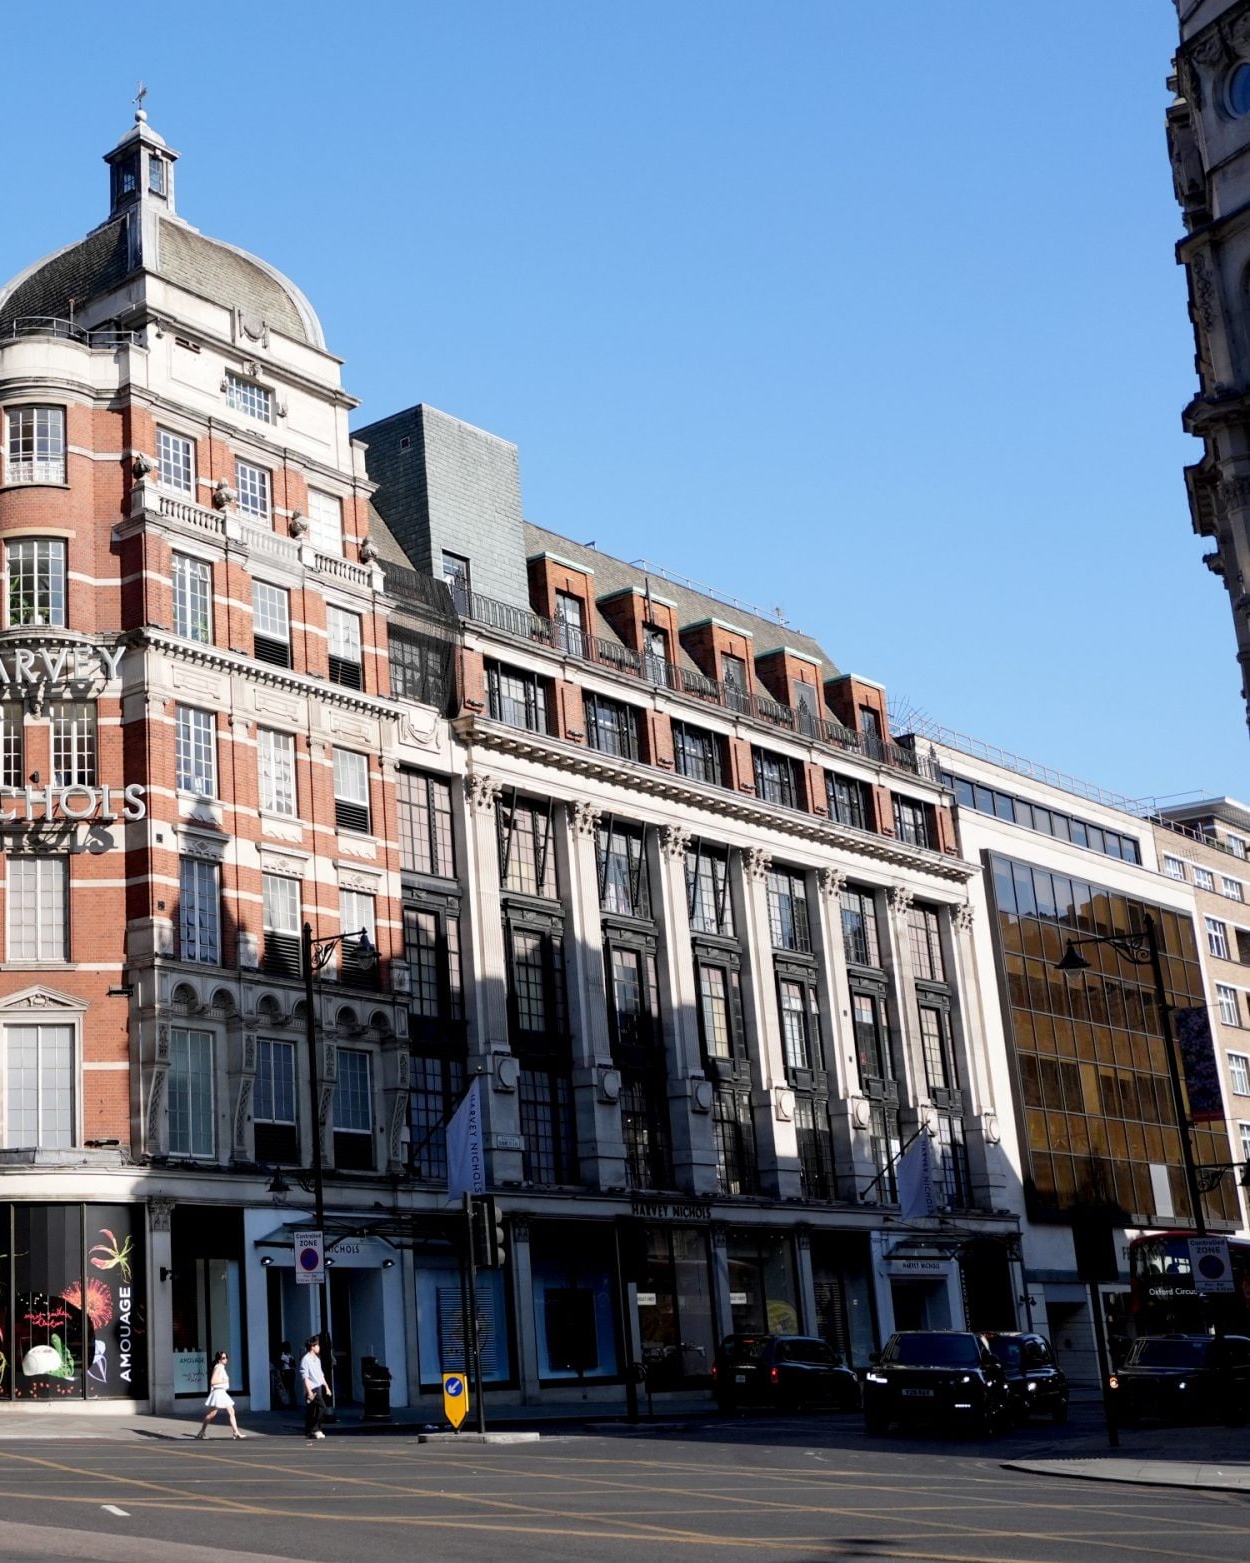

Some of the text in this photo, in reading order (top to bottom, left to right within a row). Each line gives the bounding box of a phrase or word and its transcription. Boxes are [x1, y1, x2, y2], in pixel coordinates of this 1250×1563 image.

[470, 1143, 483, 1194] NICHOLS
[632, 1203, 712, 1219] HARVEY NICHOLS
[1196, 1246, 1221, 1254] ZONE
[1149, 1287, 1174, 1296] Oxford
[119, 1287, 132, 1383] AMOUAGE
